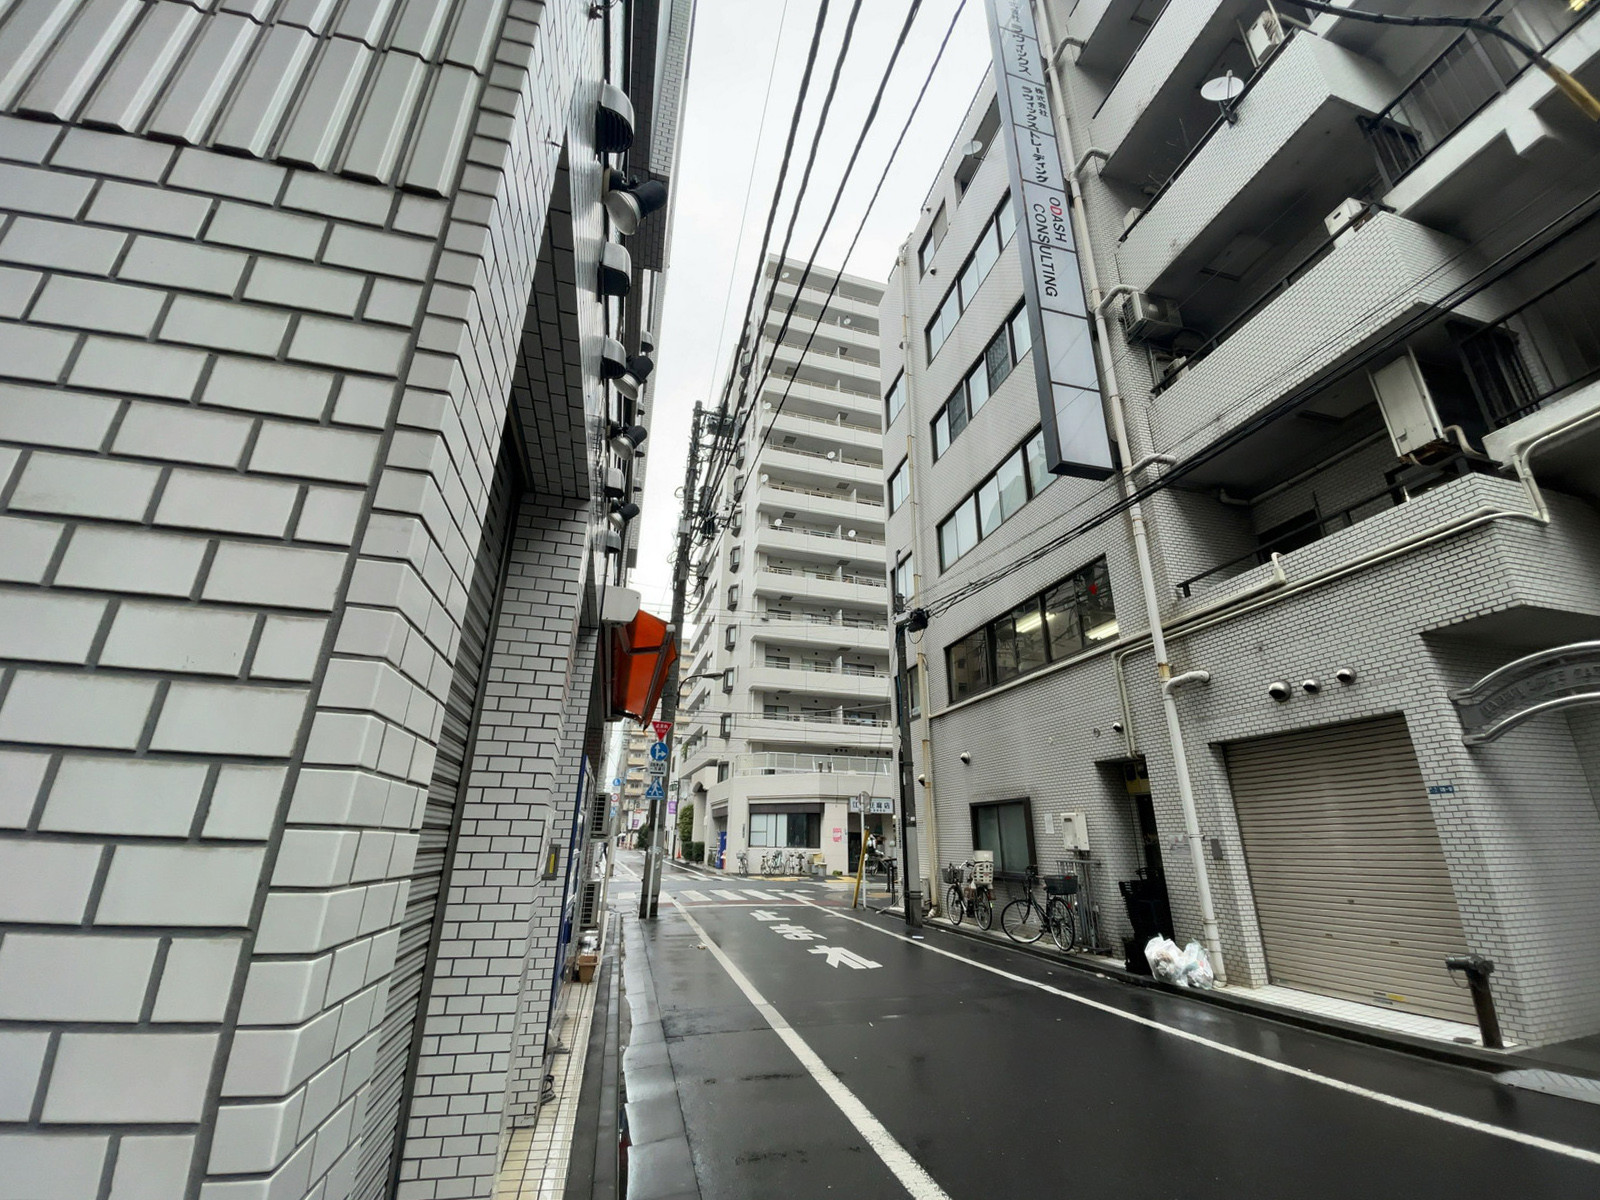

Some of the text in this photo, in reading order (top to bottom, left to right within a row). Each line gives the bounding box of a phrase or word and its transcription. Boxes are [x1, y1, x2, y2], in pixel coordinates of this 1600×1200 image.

[1049, 196, 1067, 243] ODASH
[1033, 203, 1058, 298] CONSULTING
[852, 801, 891, 809] 江豆腐店
[749, 909, 883, 970] 止まれ
